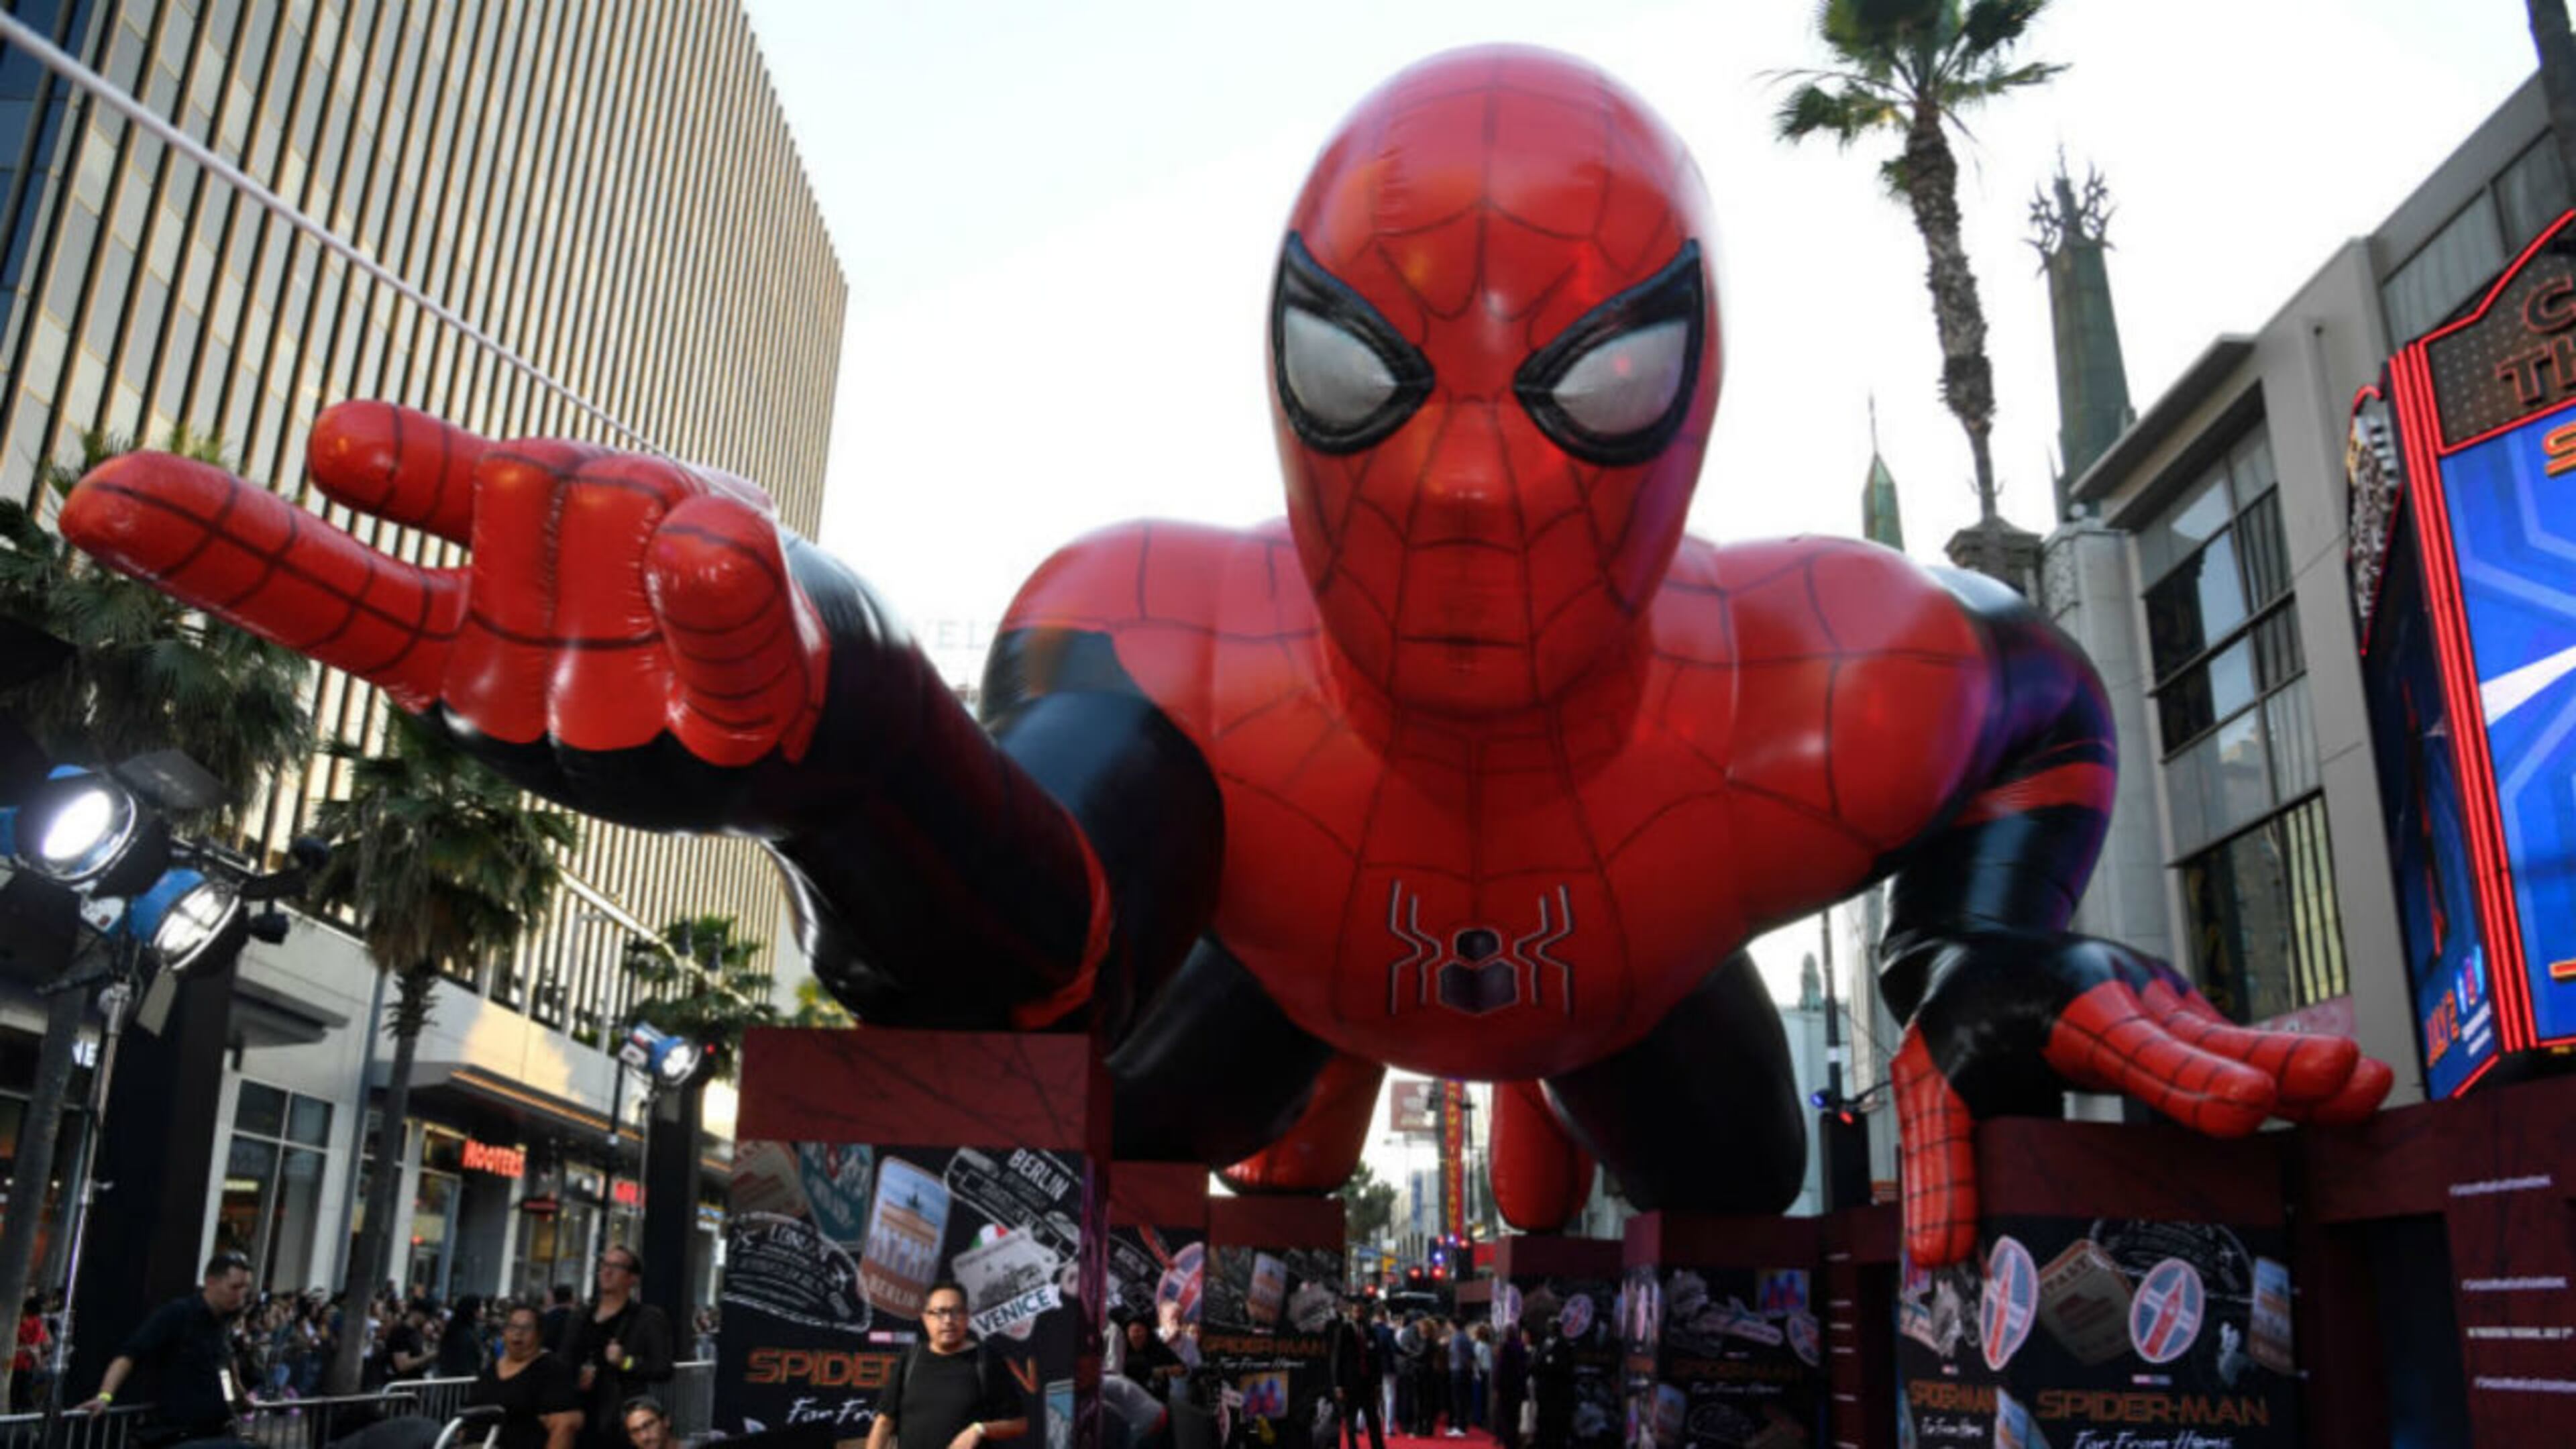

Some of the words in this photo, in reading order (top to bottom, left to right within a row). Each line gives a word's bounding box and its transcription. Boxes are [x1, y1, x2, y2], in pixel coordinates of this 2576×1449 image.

[463, 1138, 526, 1177] HOOTERS
[1008, 1148, 1070, 1200] BERLIN
[869, 1275, 920, 1307] BERLIN
[975, 1287, 1053, 1334] VENICE
[786, 1396, 834, 1426] Far
[835, 1397, 877, 1426] Fro
[2037, 1390, 2268, 1426] SPIDER-MAN
